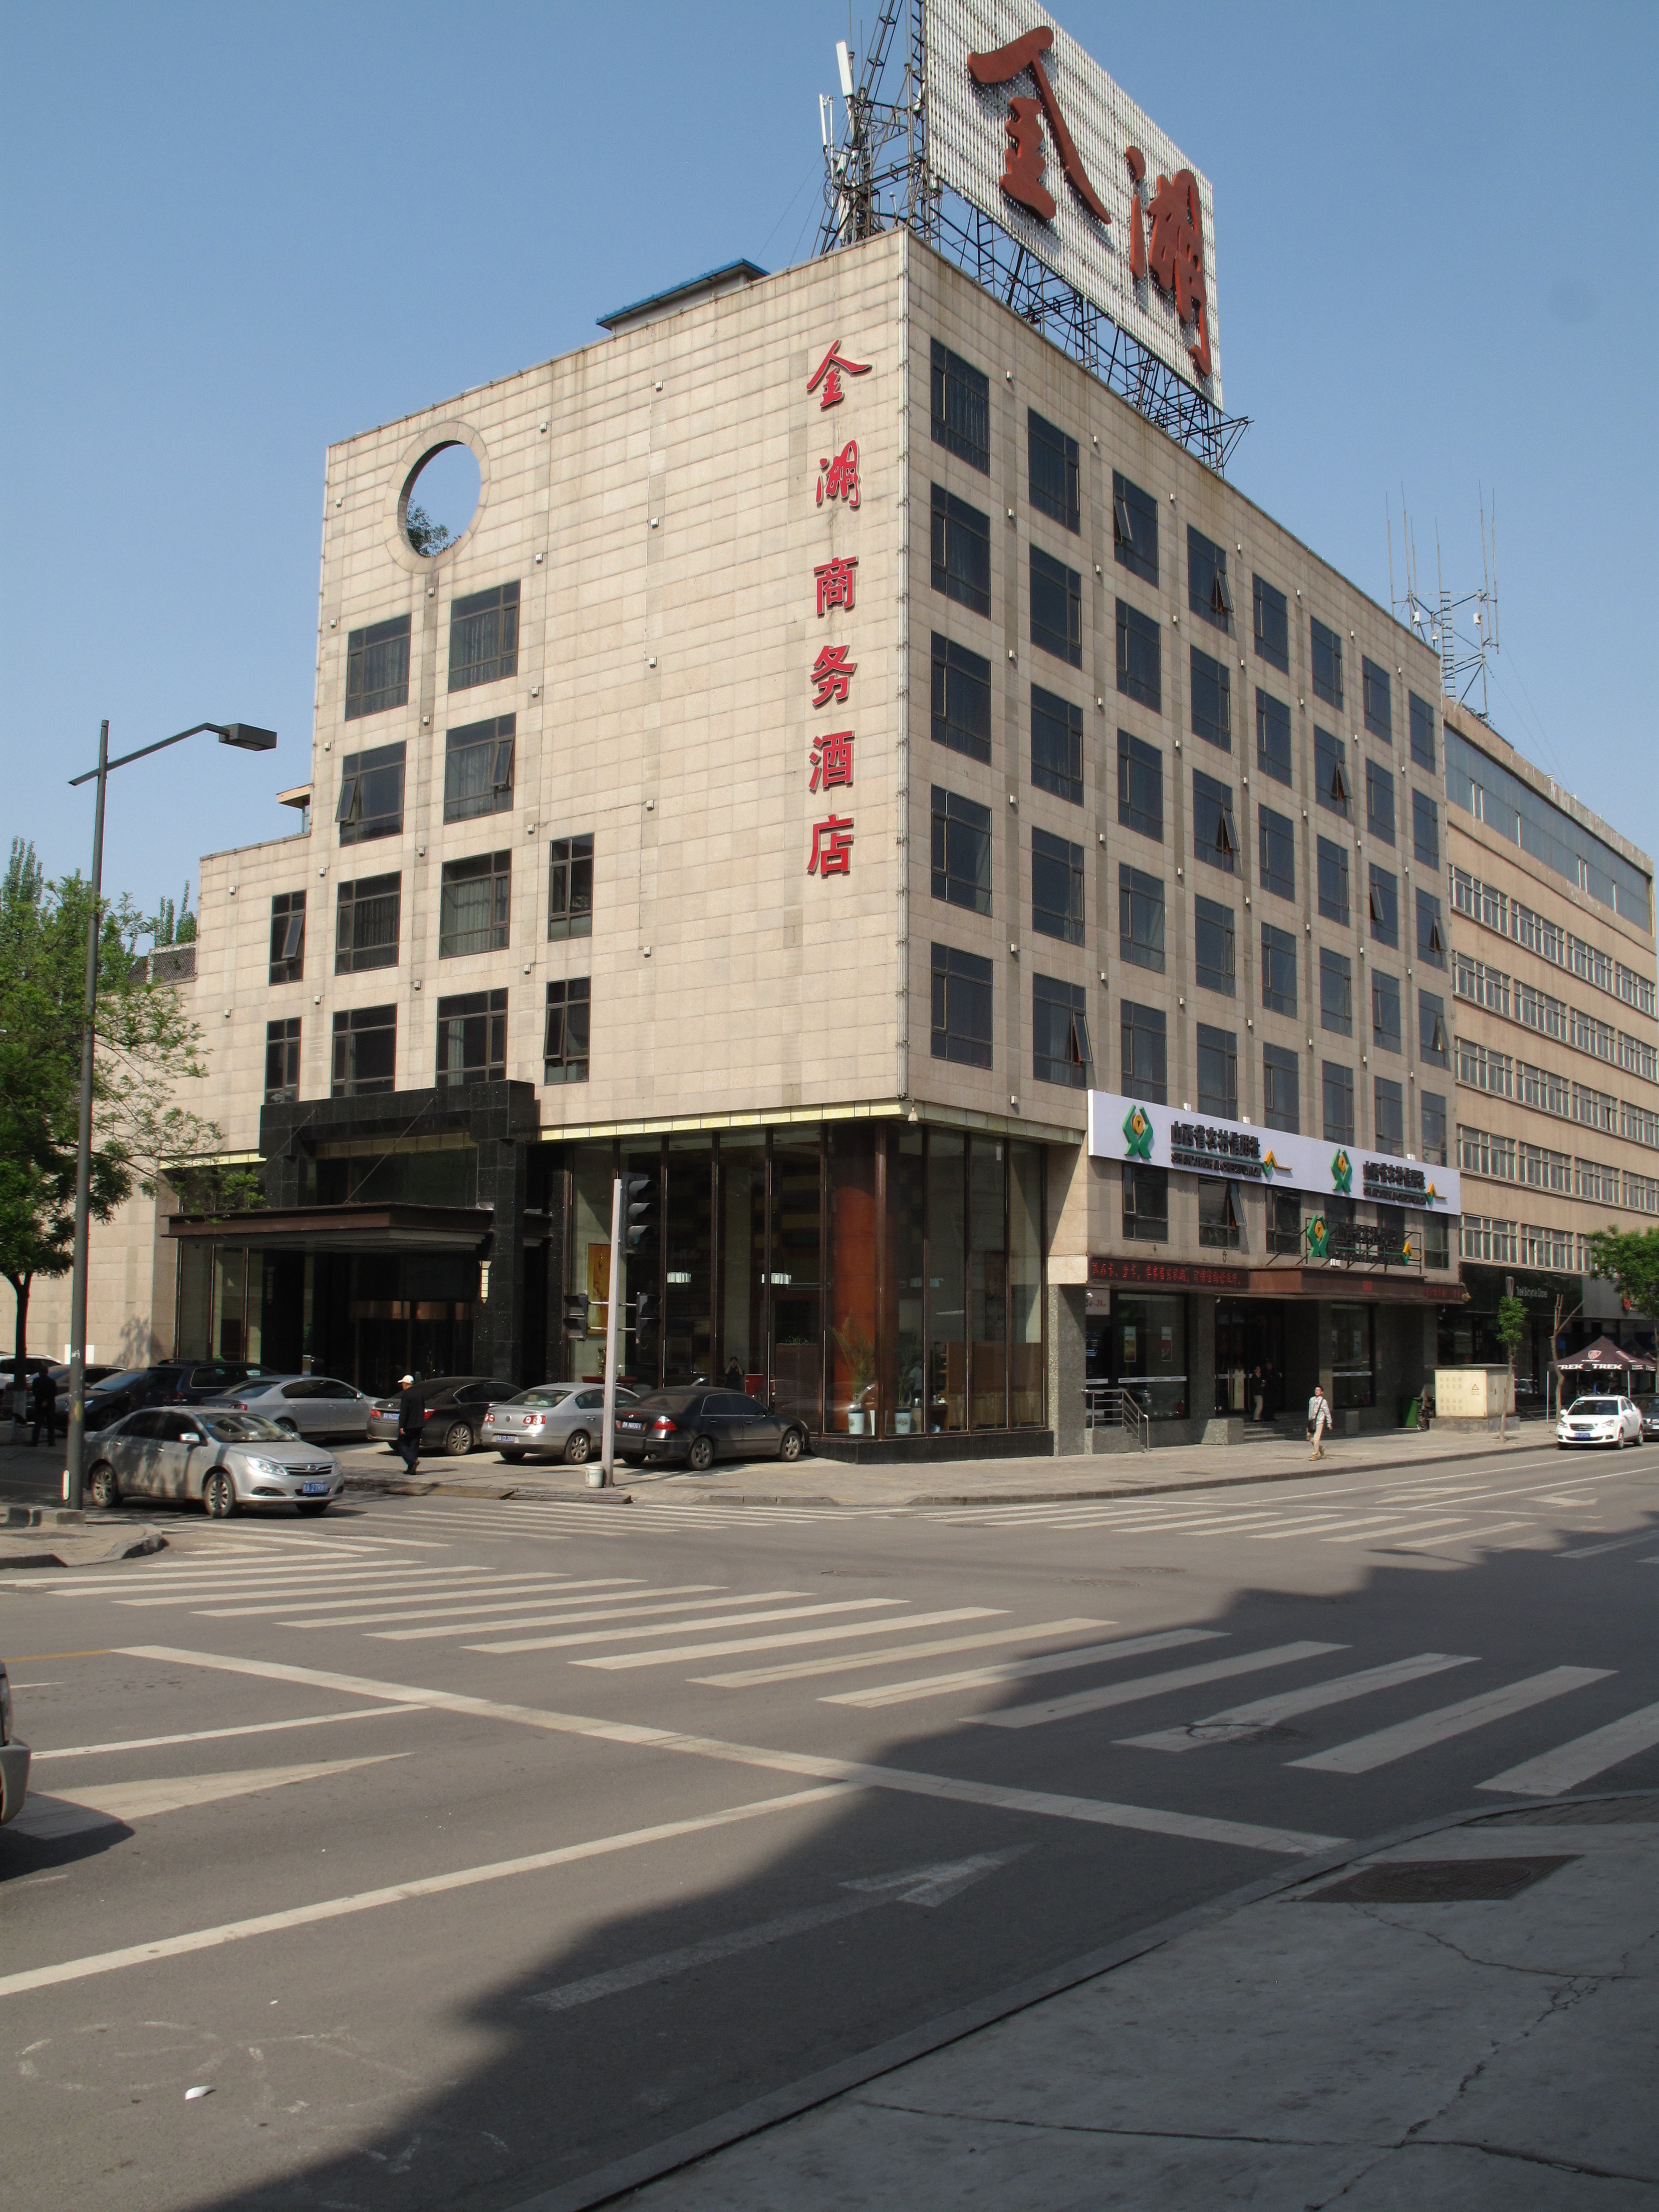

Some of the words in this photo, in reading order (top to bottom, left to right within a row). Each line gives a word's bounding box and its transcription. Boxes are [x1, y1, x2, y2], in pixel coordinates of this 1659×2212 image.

[967, 26, 1211, 376] 金湖
[806, 338, 873, 878] 金湖商务酒店
[1171, 1121, 1261, 1159] 山西省农村信用社
